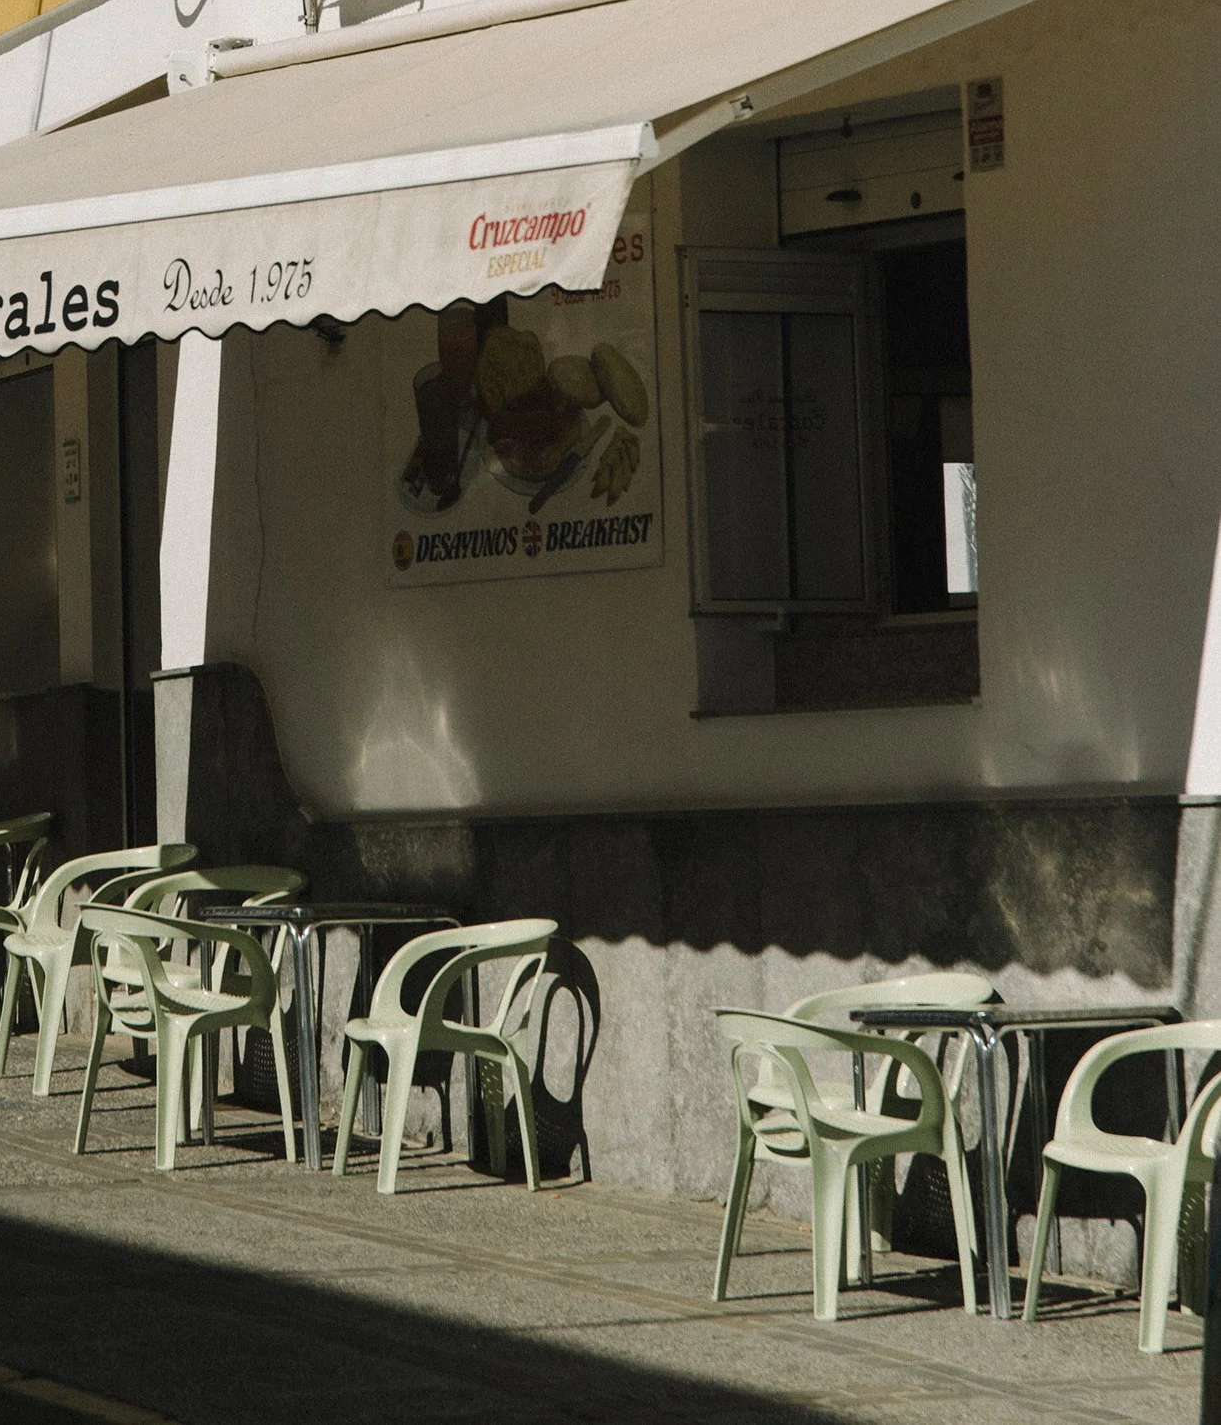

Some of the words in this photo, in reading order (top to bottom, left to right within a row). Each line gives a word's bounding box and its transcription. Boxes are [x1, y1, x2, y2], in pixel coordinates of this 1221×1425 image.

[468, 208, 586, 251] Cruzcampo
[163, 258, 234, 313] Desde
[248, 257, 315, 304] 1.975
[486, 248, 546, 278] ESPECIAL
[415, 526, 520, 563] DESAYUNOS
[545, 513, 653, 553] BREAKFAST
